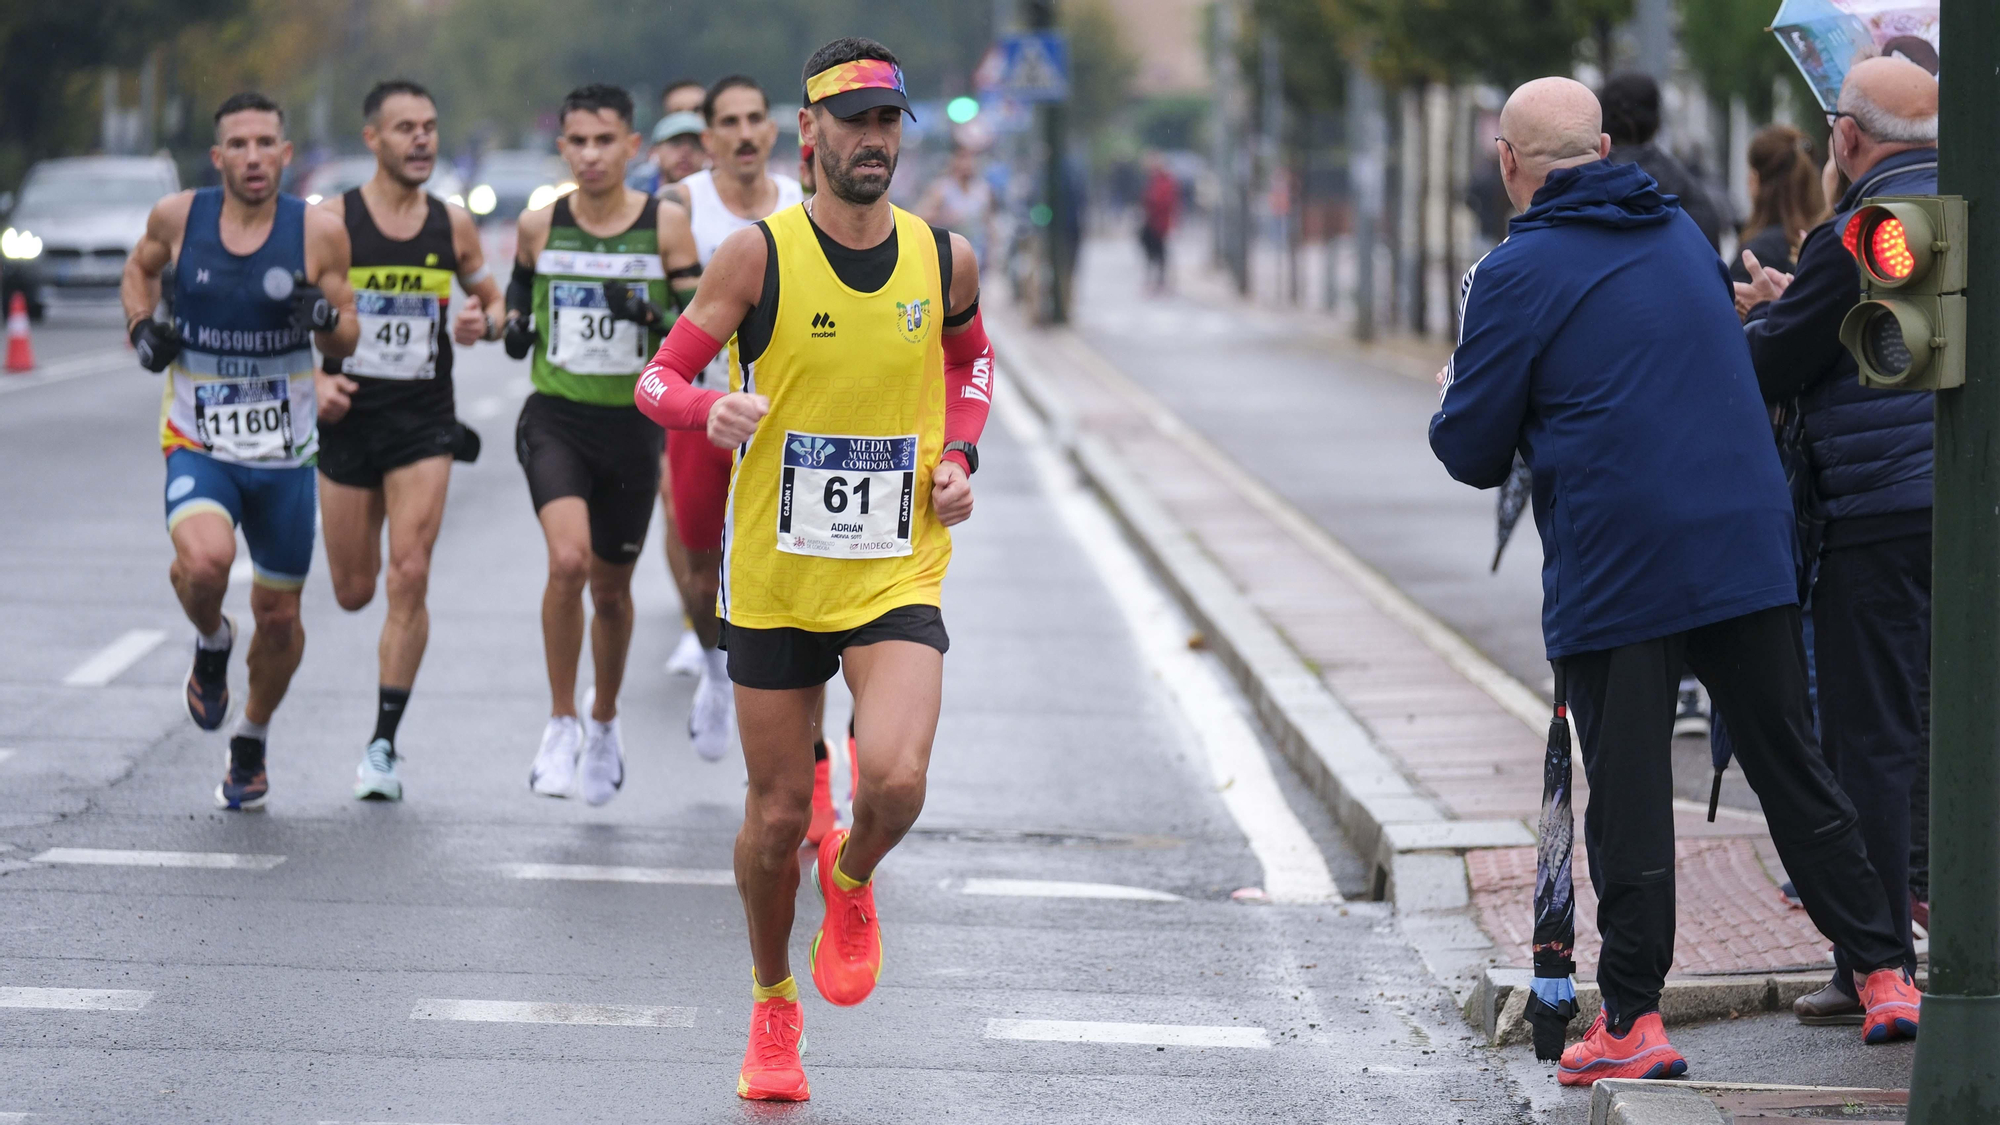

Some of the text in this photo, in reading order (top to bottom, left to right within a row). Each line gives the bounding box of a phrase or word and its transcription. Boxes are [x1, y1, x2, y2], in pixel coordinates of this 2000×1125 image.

[375, 321, 411, 346] 49
[581, 314, 615, 340] 30
[811, 330, 836, 338] mobel
[209, 407, 280, 435] 1160
[849, 439, 892, 452] MEDIA
[800, 447, 826, 467] 39
[848, 451, 892, 460] MARATÓN
[842, 459, 895, 470] CÓRDOBA
[824, 476, 871, 514] 61
[901, 495, 909, 521] CAJÓN
[831, 522, 863, 533] ADRIÁN
[859, 541, 894, 550] IMDECO
